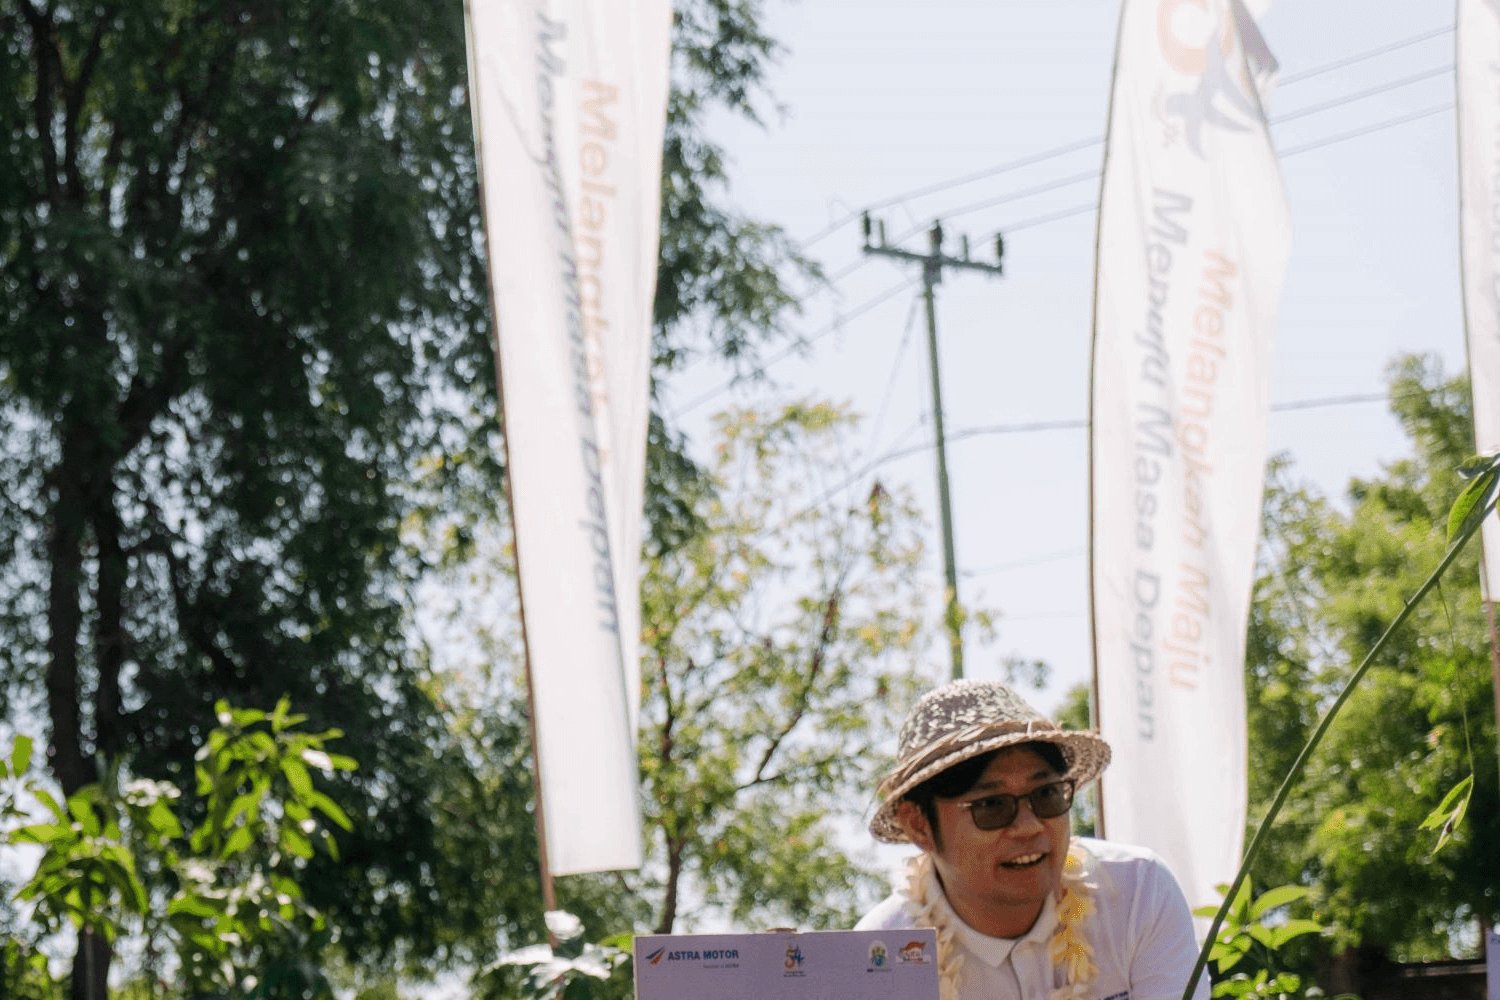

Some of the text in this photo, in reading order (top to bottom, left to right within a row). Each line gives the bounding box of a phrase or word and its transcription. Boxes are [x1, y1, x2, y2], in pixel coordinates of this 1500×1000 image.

[1130, 184, 1196, 744] Menuju Masa Depan
[1161, 248, 1240, 692] Melangkah Maju
[668, 949, 740, 961] ASTRA MOTOR
